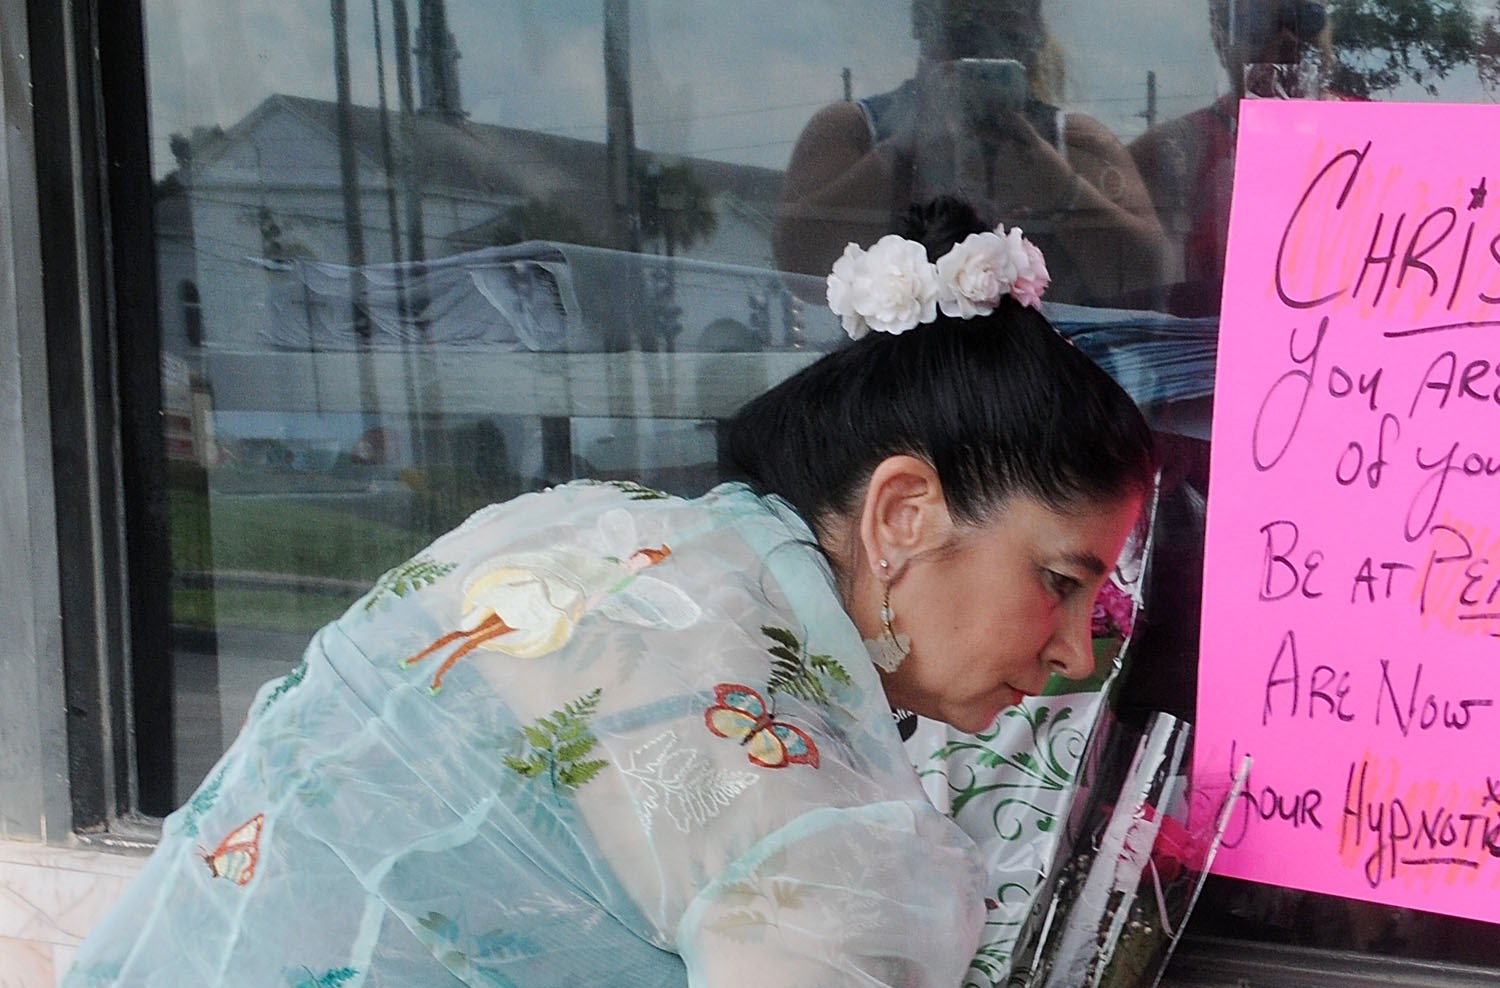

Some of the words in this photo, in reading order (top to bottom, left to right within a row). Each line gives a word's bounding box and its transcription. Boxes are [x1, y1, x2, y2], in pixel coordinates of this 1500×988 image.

[1259, 520, 1323, 601] BE
[1352, 557, 1415, 603] AT
[1263, 630, 1355, 726] ARE
